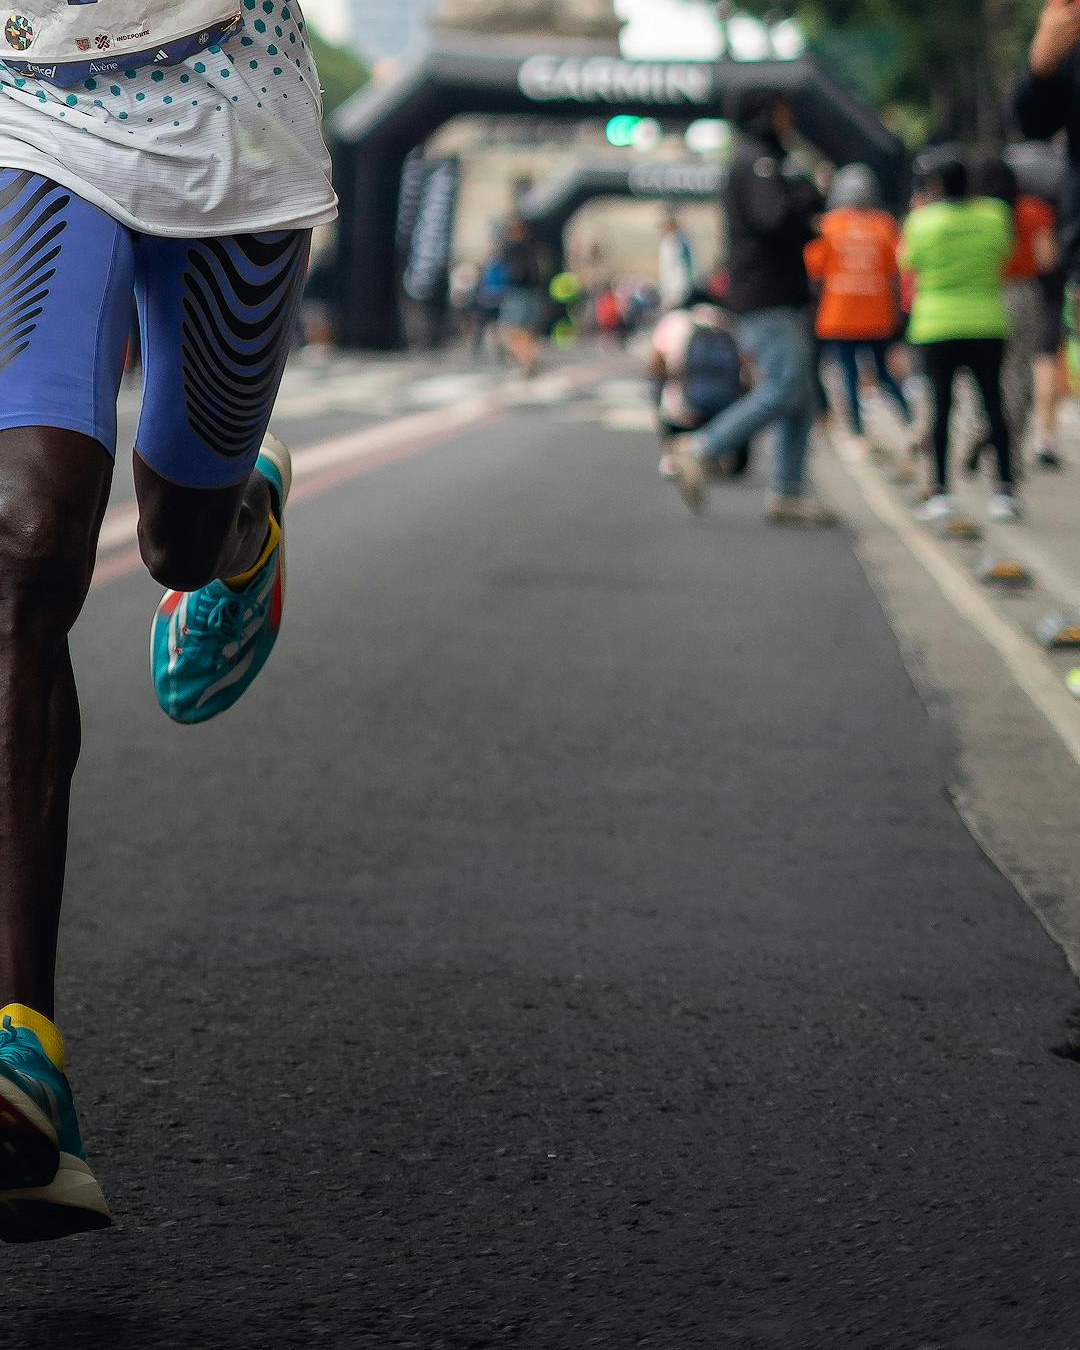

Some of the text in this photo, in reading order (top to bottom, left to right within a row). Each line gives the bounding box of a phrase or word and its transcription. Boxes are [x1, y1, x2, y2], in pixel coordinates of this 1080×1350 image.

[116, 29, 151, 43] INDEPORTE
[27, 63, 56, 79] telcel
[88, 60, 118, 75] Avène
[519, 56, 713, 103] GARMIN
